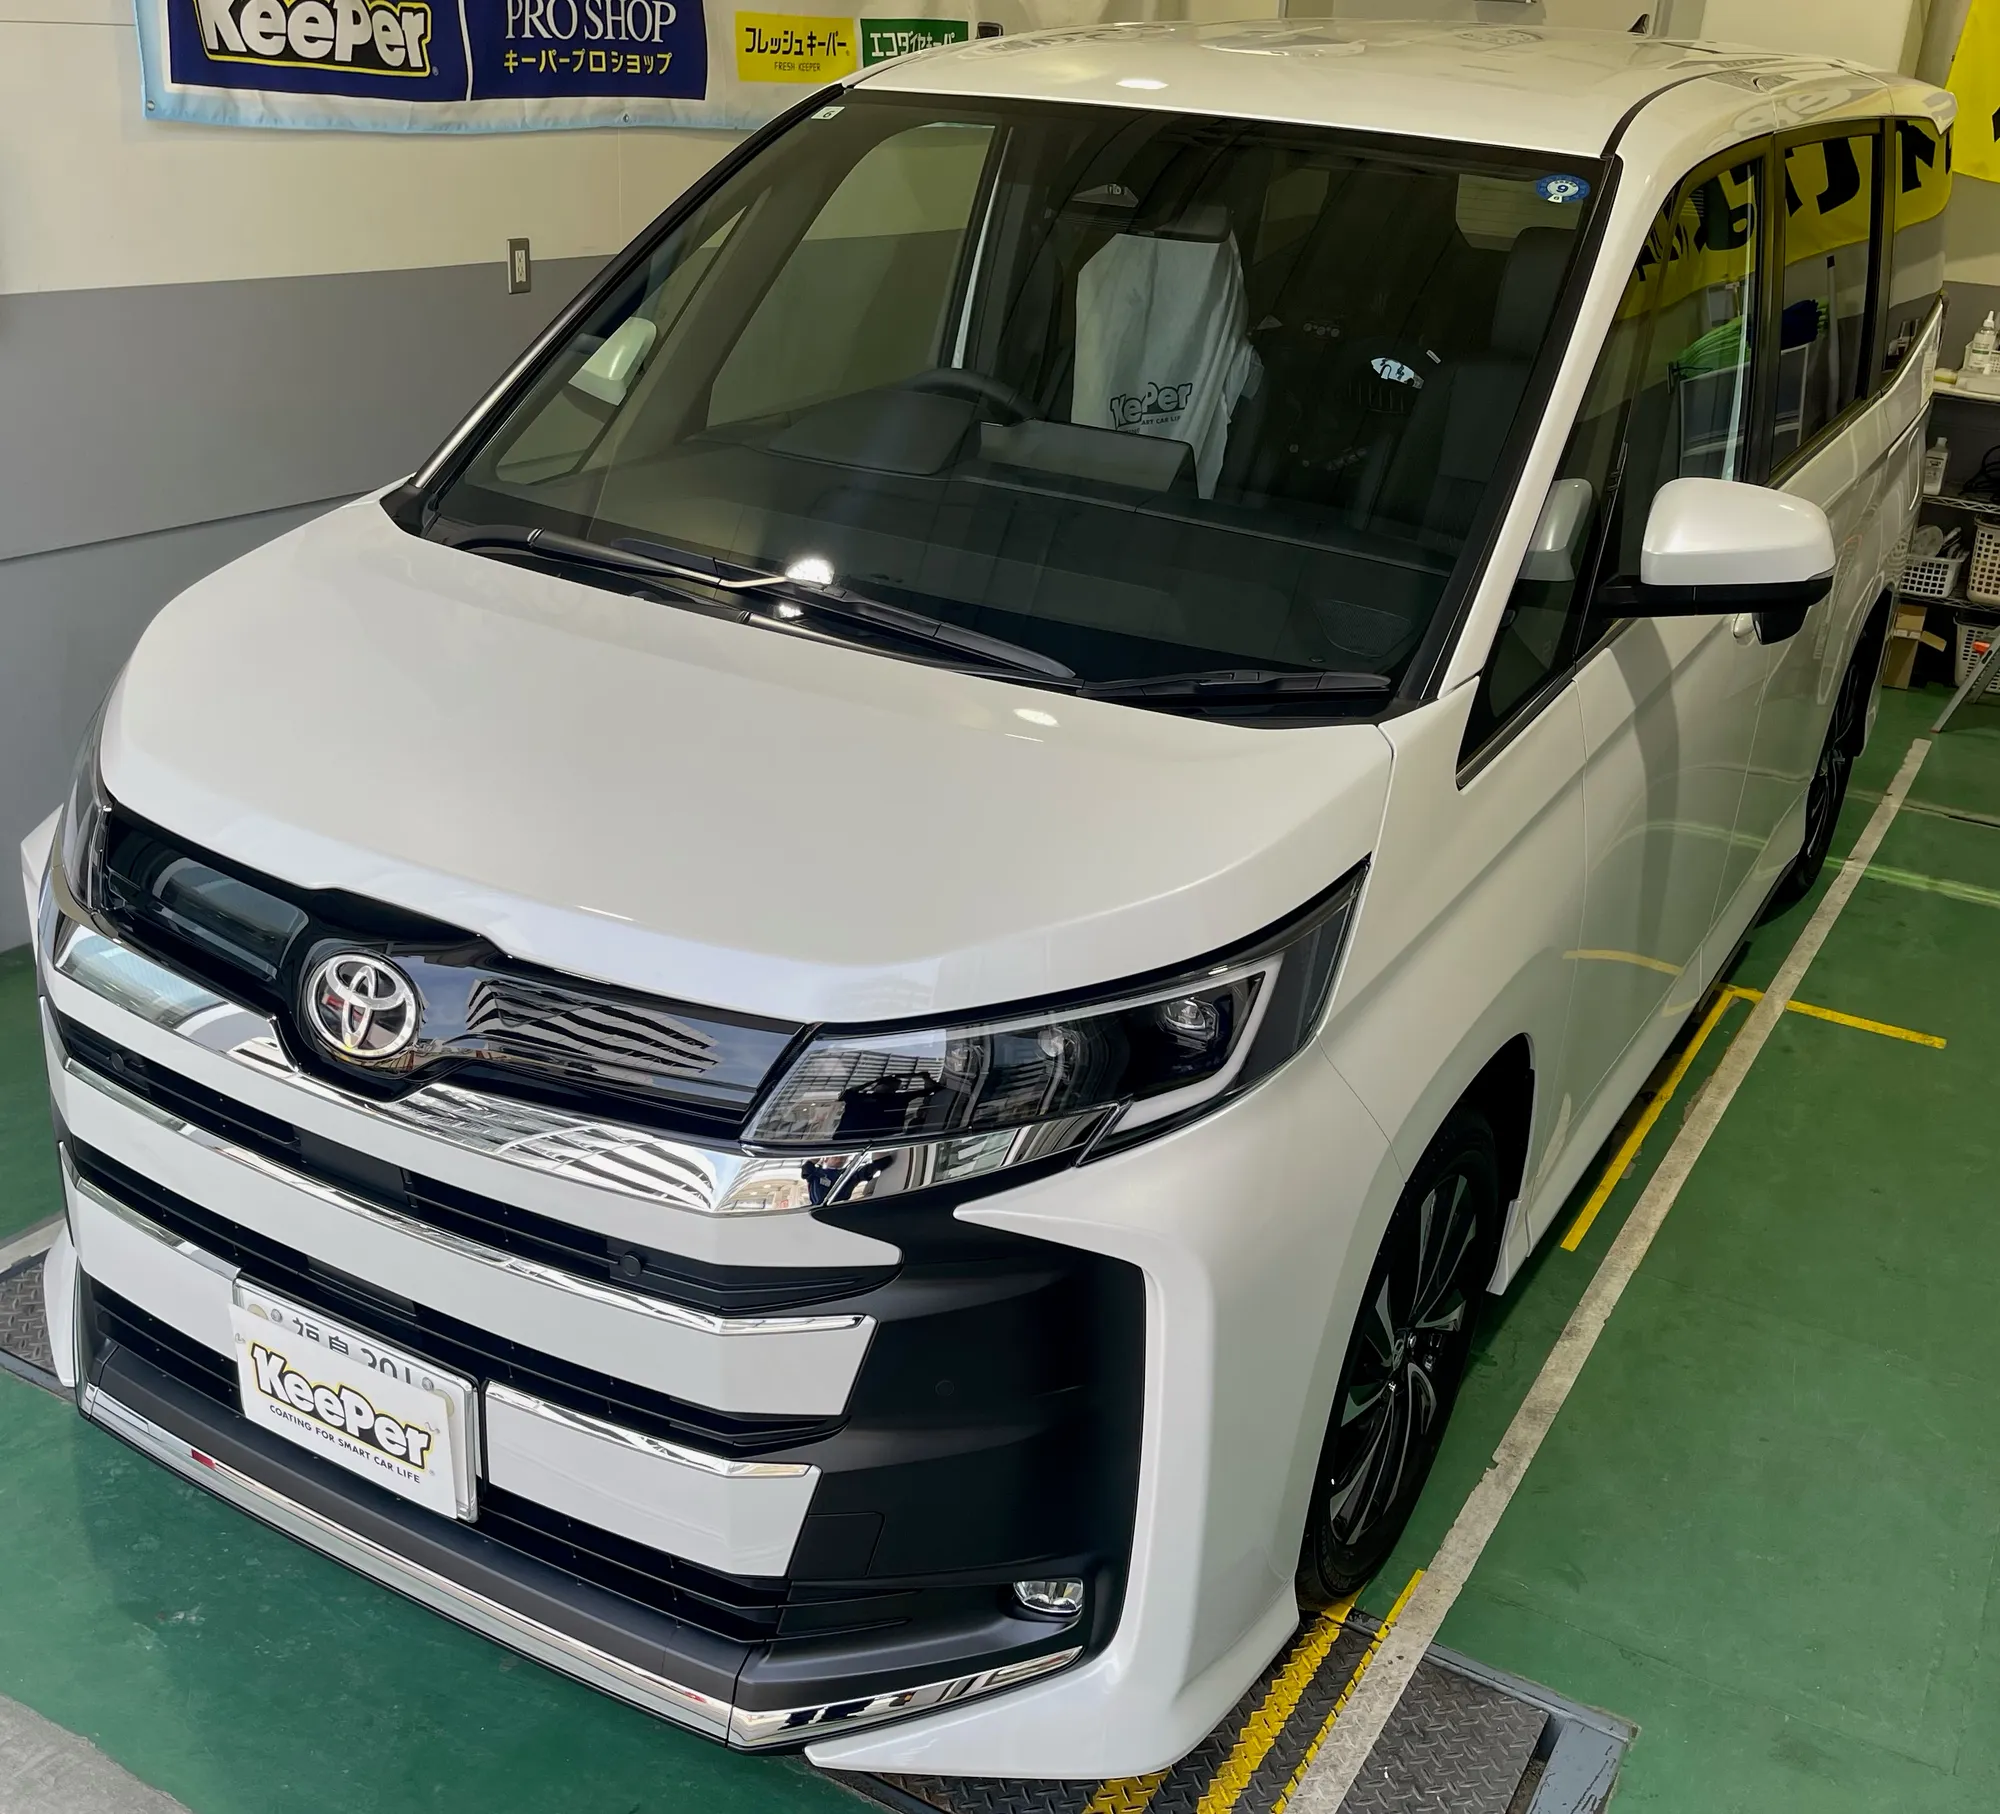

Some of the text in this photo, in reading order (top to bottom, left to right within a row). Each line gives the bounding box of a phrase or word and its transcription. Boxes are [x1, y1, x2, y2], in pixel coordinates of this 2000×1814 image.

[196, 0, 427, 70] KeePer
[505, 0, 677, 43] PRO SHOP
[745, 27, 847, 57] フレッシュキーパー
[870, 31, 955, 57] エコダイヤキーパ
[503, 48, 673, 75] キーパープロショップ
[774, 62, 821, 72] FRESH KEEPER
[1556, 184, 1569, 194] 9
[251, 1343, 431, 1470] KeePer
[269, 1404, 421, 1484] COATING FOR SMART CAR LIFE
